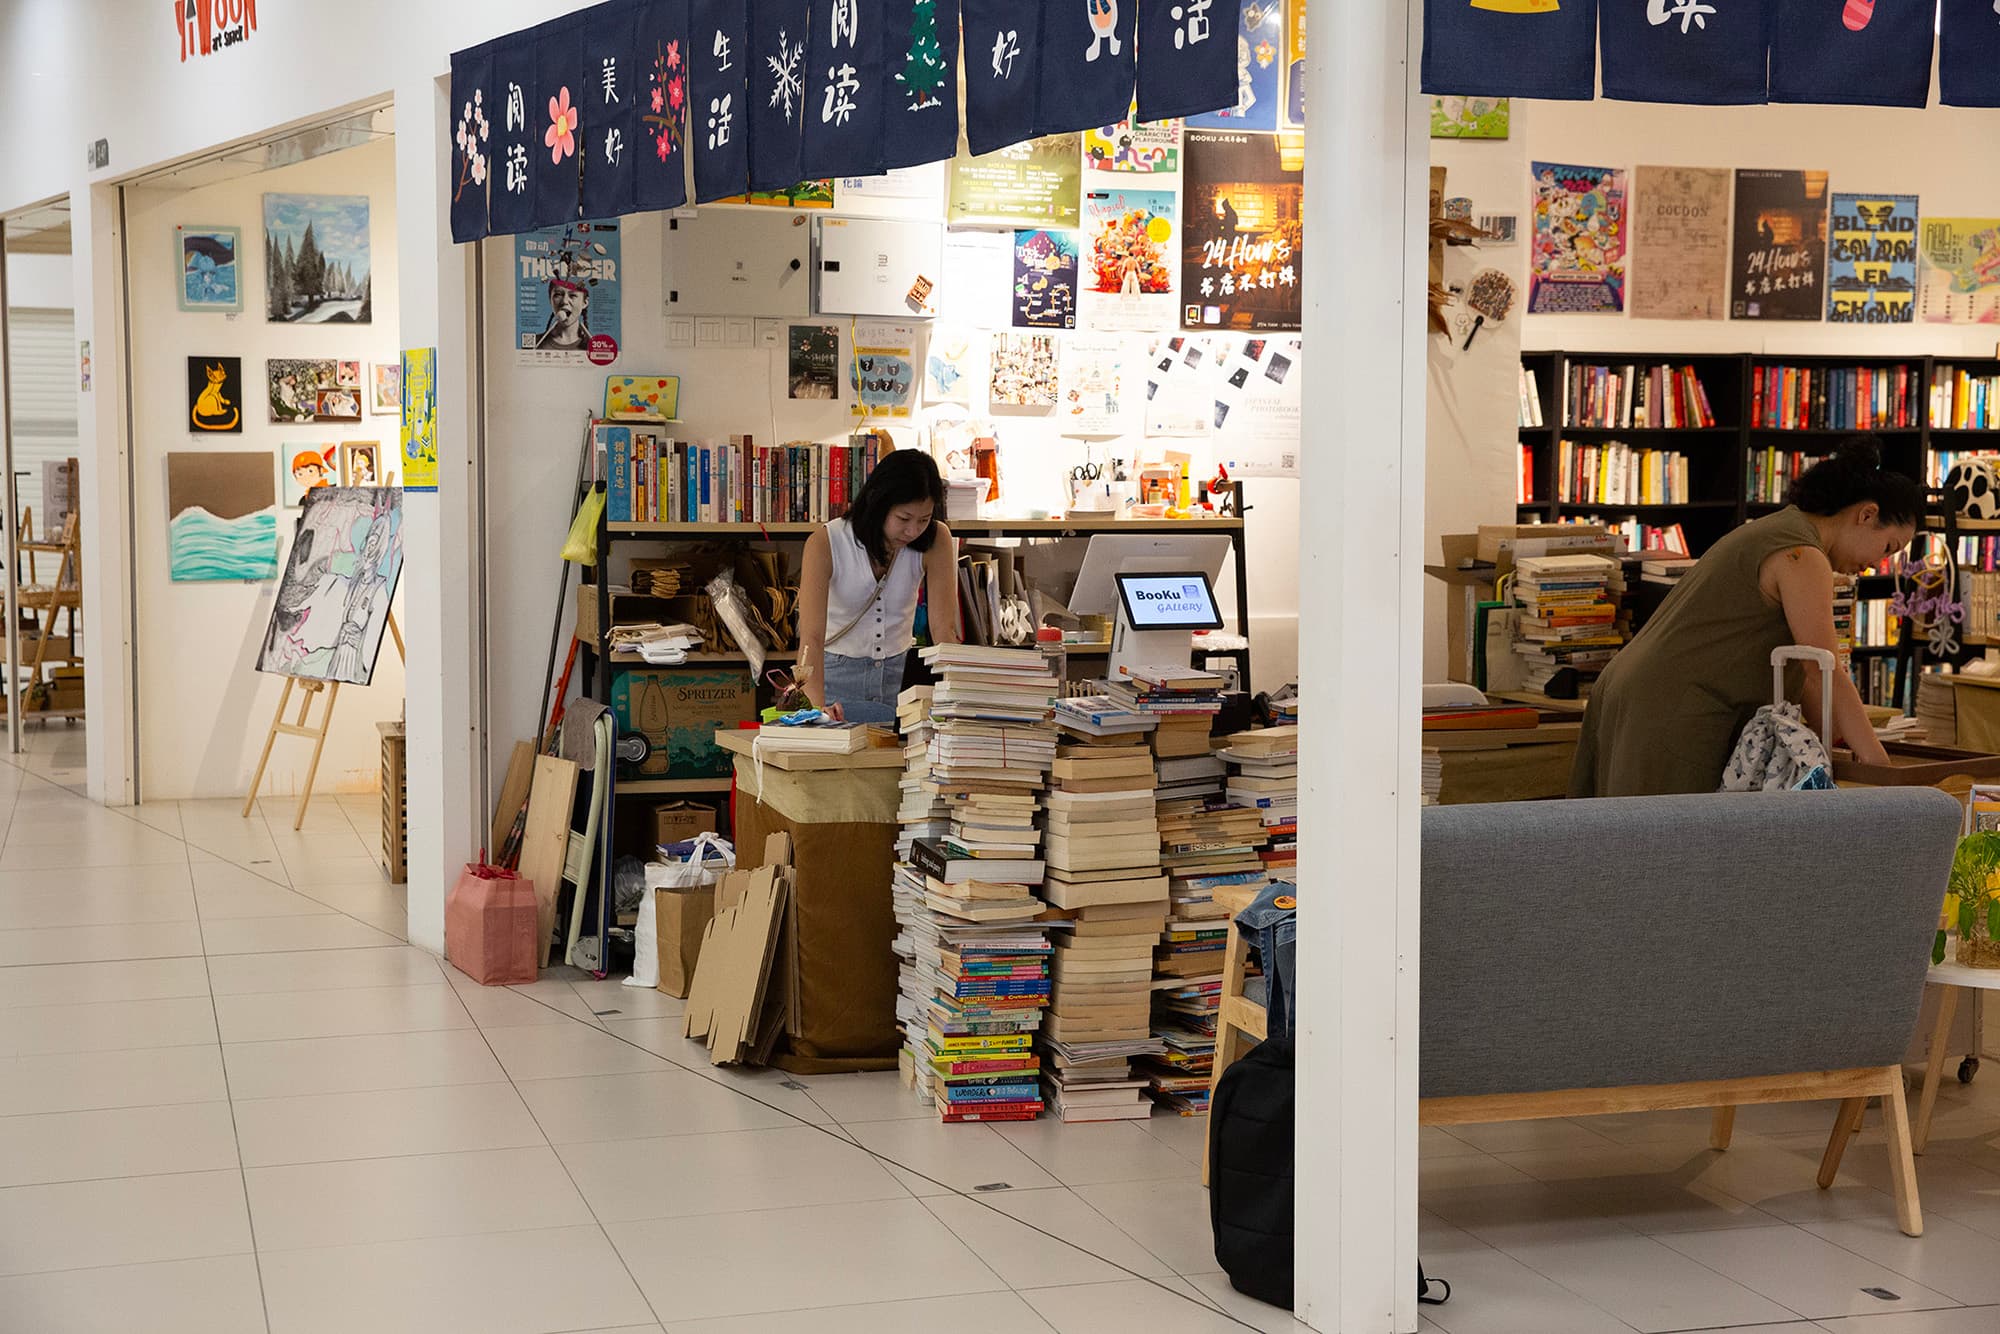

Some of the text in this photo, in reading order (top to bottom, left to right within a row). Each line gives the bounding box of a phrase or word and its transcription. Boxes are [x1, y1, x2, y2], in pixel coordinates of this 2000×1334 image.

[708, 30, 733, 150] 生活
[992, 30, 1020, 79] 好
[506, 81, 528, 194] 阅读
[602, 57, 623, 167] 美好
[1202, 239, 1227, 269] 24
[1135, 590, 1181, 600] BooKu
